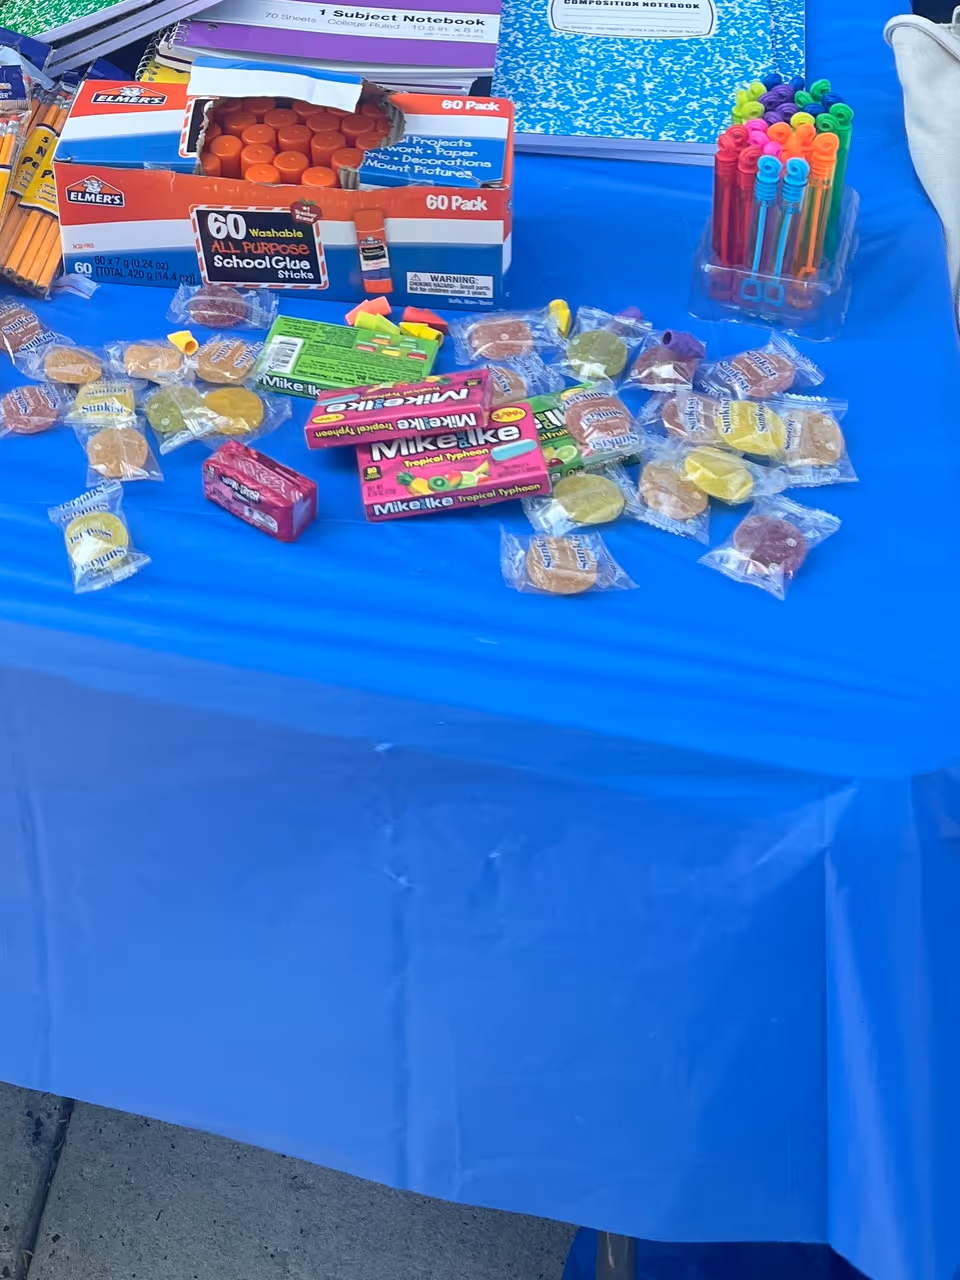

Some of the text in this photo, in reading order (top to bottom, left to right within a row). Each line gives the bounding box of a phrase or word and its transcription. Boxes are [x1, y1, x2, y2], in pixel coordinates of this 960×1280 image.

[564, 0, 700, 9] COMPOSITION NOTEBOOK
[281, 13, 316, 23] Sheets
[327, 18, 367, 28] College
[369, 22, 400, 30] Ruled
[319, 8, 486, 26] 1 Subject Notebook
[96, 94, 163, 105] ELMER'S
[441, 100, 500, 111] 60 Pack
[412, 137, 472, 148] Projects
[402, 155, 492, 168] Decorations
[436, 148, 478, 158] Paper
[366, 159, 473, 179] Mount Pictures
[70, 191, 123, 205] ELMER'S
[426, 194, 487, 211] 60 Pack
[208, 212, 304, 240] 60 Washable
[212, 240, 310, 255] ALL PURPOSE
[74, 262, 92, 274] 60
[94, 256, 106, 265] 60
[115, 257, 121, 265] 7
[123, 260, 130, 269] g
[132, 259, 153, 269] (0.24
[156, 262, 169, 272] oz)
[213, 255, 311, 270] School Glue
[128, 269, 144, 279] 420
[146, 272, 153, 280] g
[155, 271, 177, 281] (14.4
[278, 270, 314, 280] Sticks
[429, 274, 479, 284] WARNING:
[2, 314, 38, 334] Sunkist
[19, 331, 56, 352] Sunkist
[746, 351, 777, 379] Sunkist
[720, 362, 751, 391] Sunkist
[262, 376, 321, 396] Mike Ik
[81, 402, 125, 414] Sunkist
[326, 388, 470, 414] Mike Ike
[685, 397, 698, 431] Sunkist
[719, 398, 732, 434] Sunkist
[315, 412, 477, 439] Mike Ike Tropical Typhoon
[371, 432, 458, 462] Mike
[470, 425, 521, 446] Ike
[593, 433, 638, 450] Sunkist
[403, 448, 489, 468] Tropical Typhoon
[373, 483, 541, 516] Mike Ike Tropical Typhoon
[81, 546, 126, 572] Sunkist
